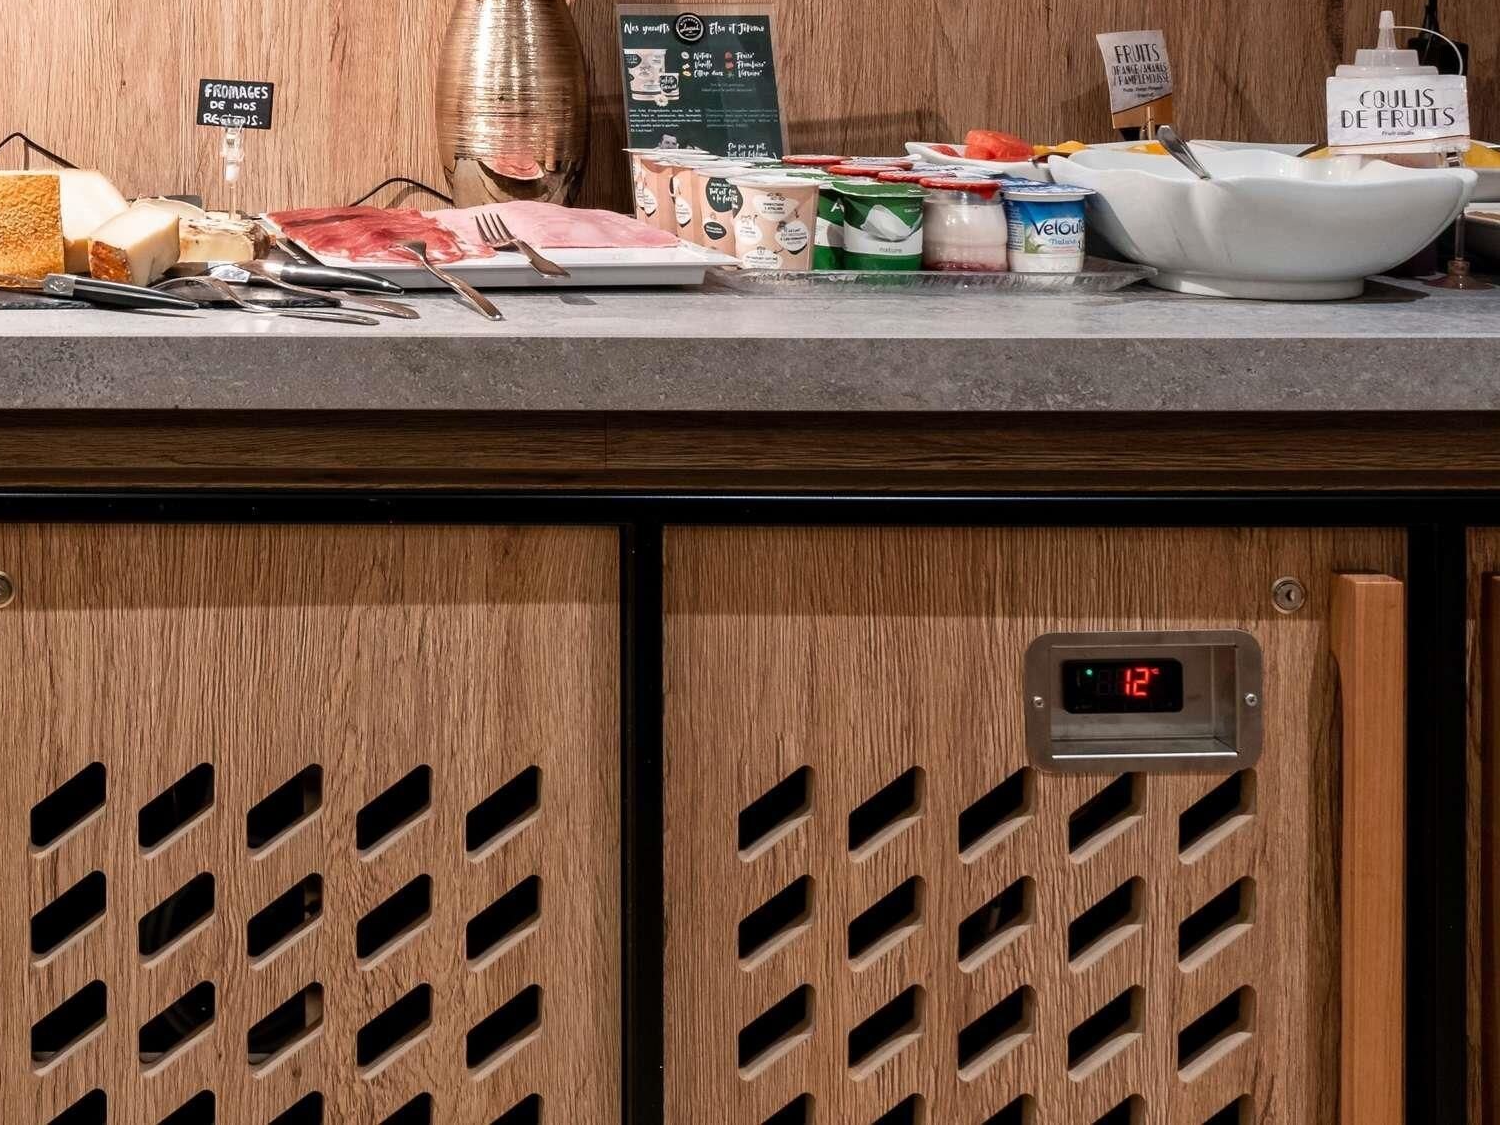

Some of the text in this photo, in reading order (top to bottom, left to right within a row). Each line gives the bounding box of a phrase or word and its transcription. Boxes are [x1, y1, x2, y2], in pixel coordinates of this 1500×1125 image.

[1113, 43, 1161, 64] FRUITS
[204, 83, 269, 100] FROMAGES
[1359, 87, 1435, 109] COULIS
[209, 101, 257, 112] DE NOS
[1340, 107, 1456, 129] DE FRUITS
